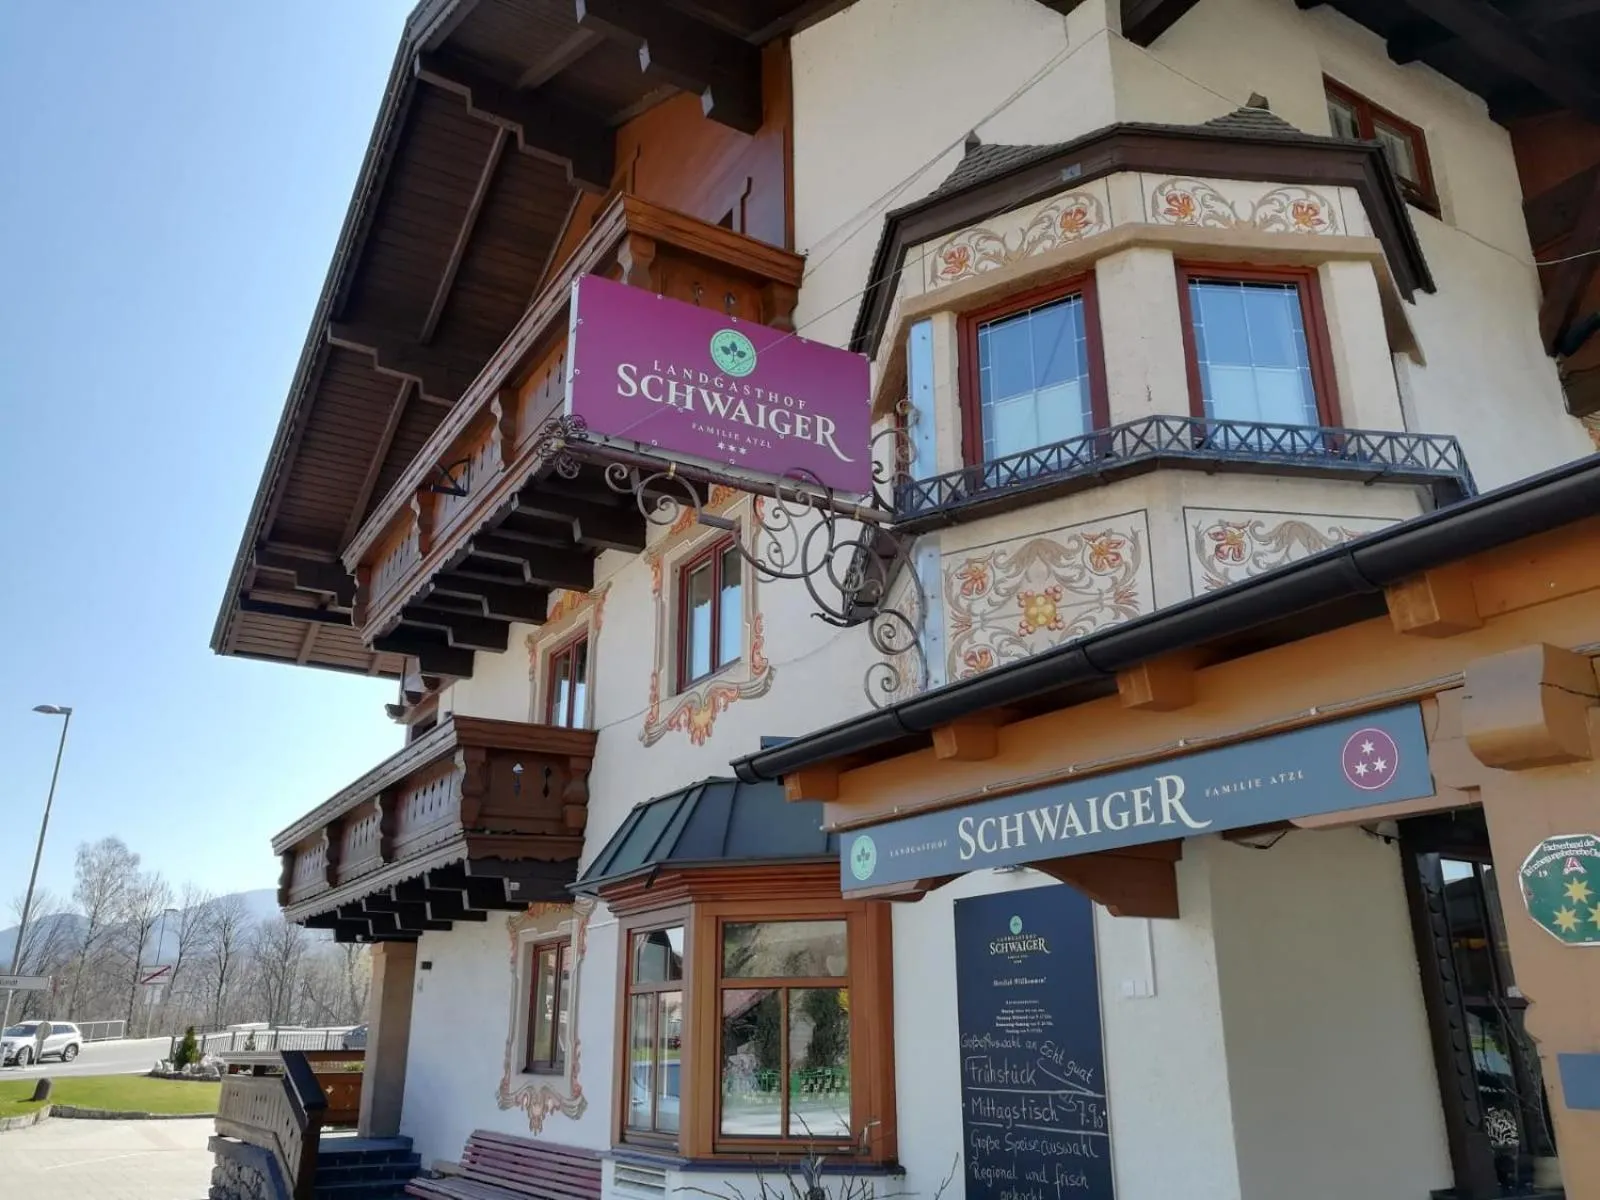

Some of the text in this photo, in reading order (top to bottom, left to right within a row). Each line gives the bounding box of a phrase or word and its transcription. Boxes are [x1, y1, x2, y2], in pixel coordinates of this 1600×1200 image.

[653, 359, 807, 410] LANDGASTHOF
[617, 362, 856, 463] SCHWAIGER
[692, 422, 740, 441] FAMILIE
[957, 774, 1213, 861] SCHWAIGER
[1205, 777, 1262, 798] FAMILIE
[1270, 768, 1304, 785] ATZL
[989, 937, 1051, 955] SCHWAIGER
[965, 1055, 1037, 1087] Frühstück
[971, 1096, 1060, 1129] Mittagstisch
[970, 1128, 1000, 1159] Große
[969, 1160, 1089, 1200] Regional und frisch
